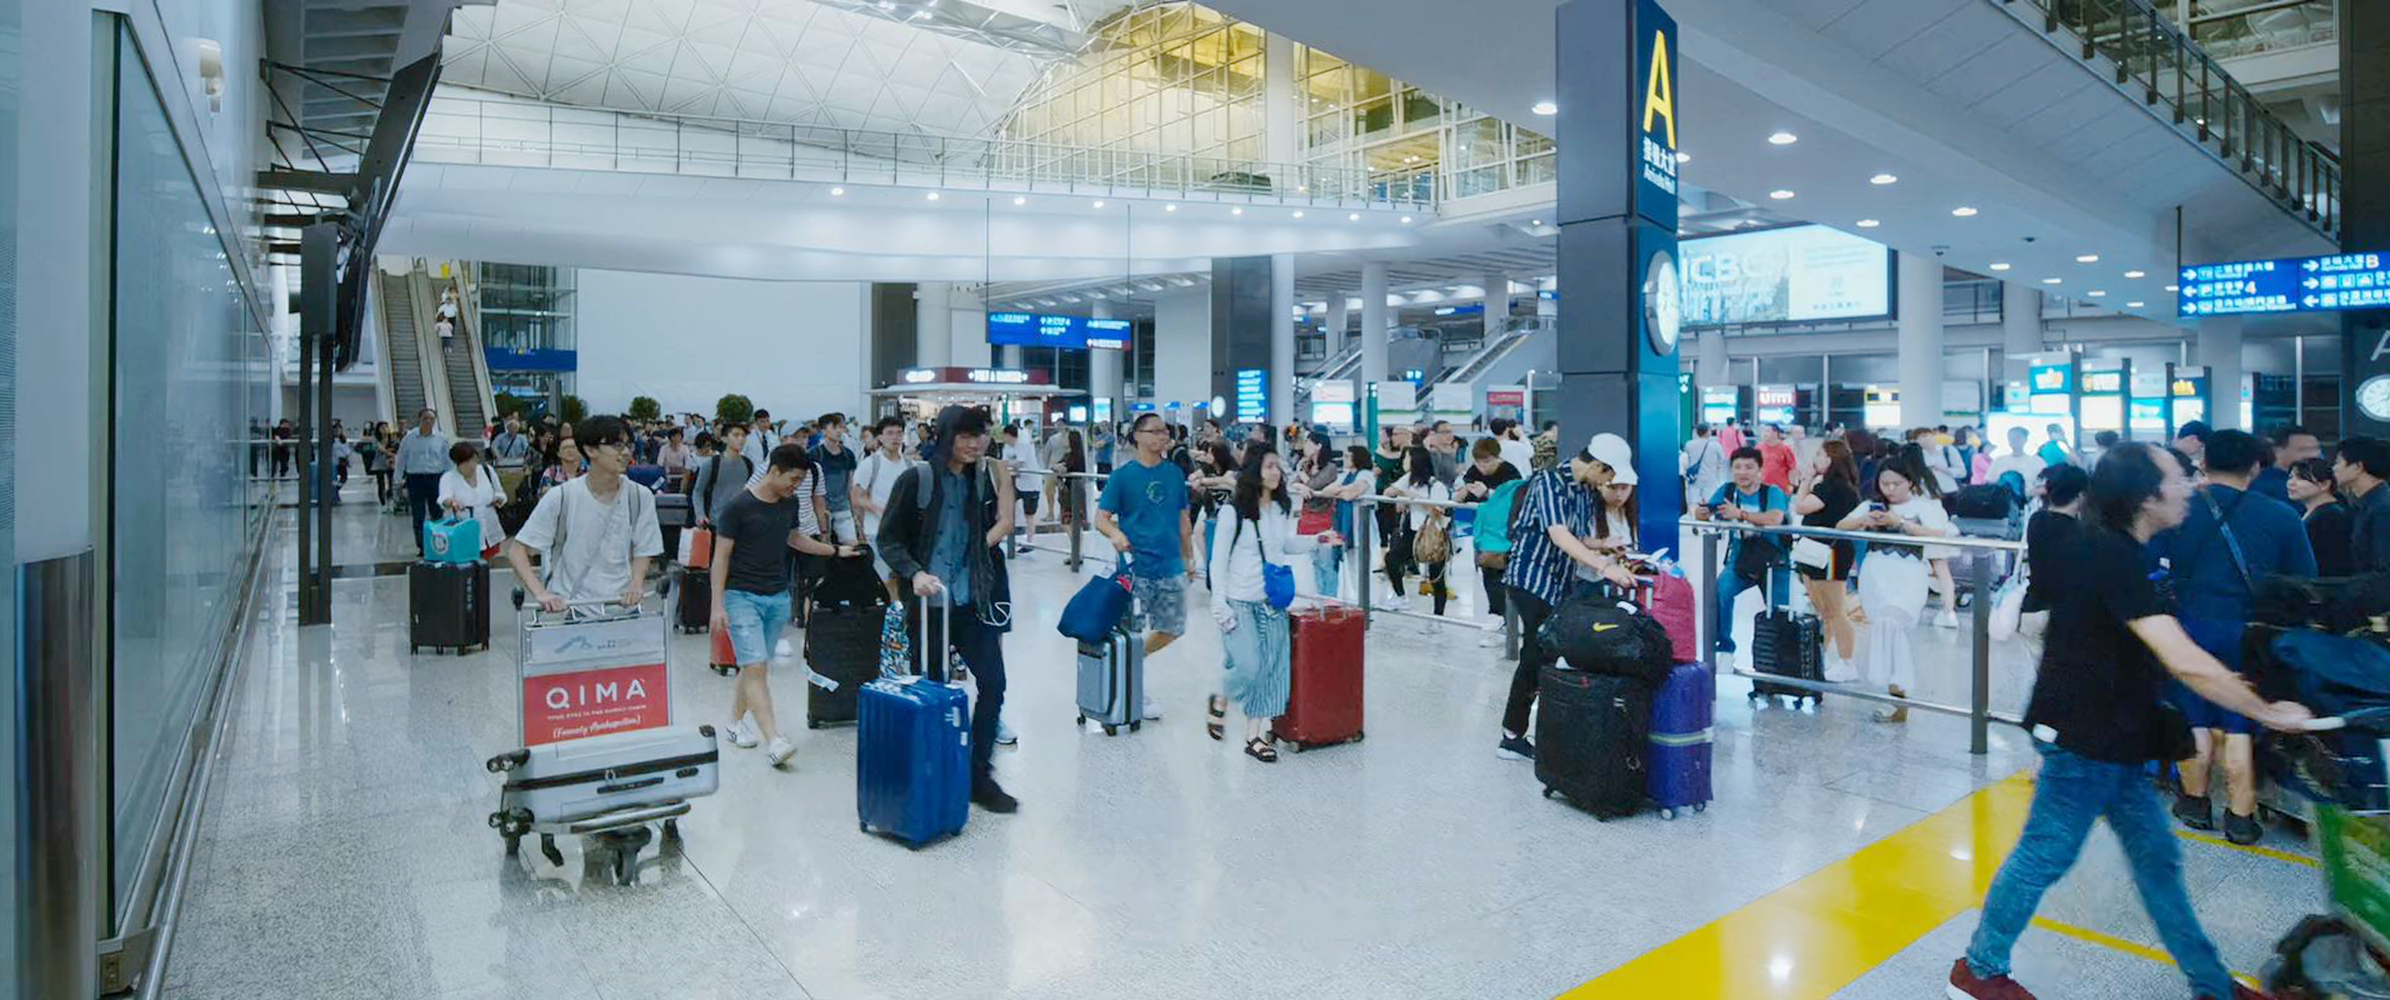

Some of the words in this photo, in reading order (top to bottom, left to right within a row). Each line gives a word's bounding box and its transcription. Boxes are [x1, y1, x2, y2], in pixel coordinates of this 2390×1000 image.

[1643, 29, 1676, 150] A
[2366, 254, 2379, 269] B
[546, 679, 646, 709] QIMA
